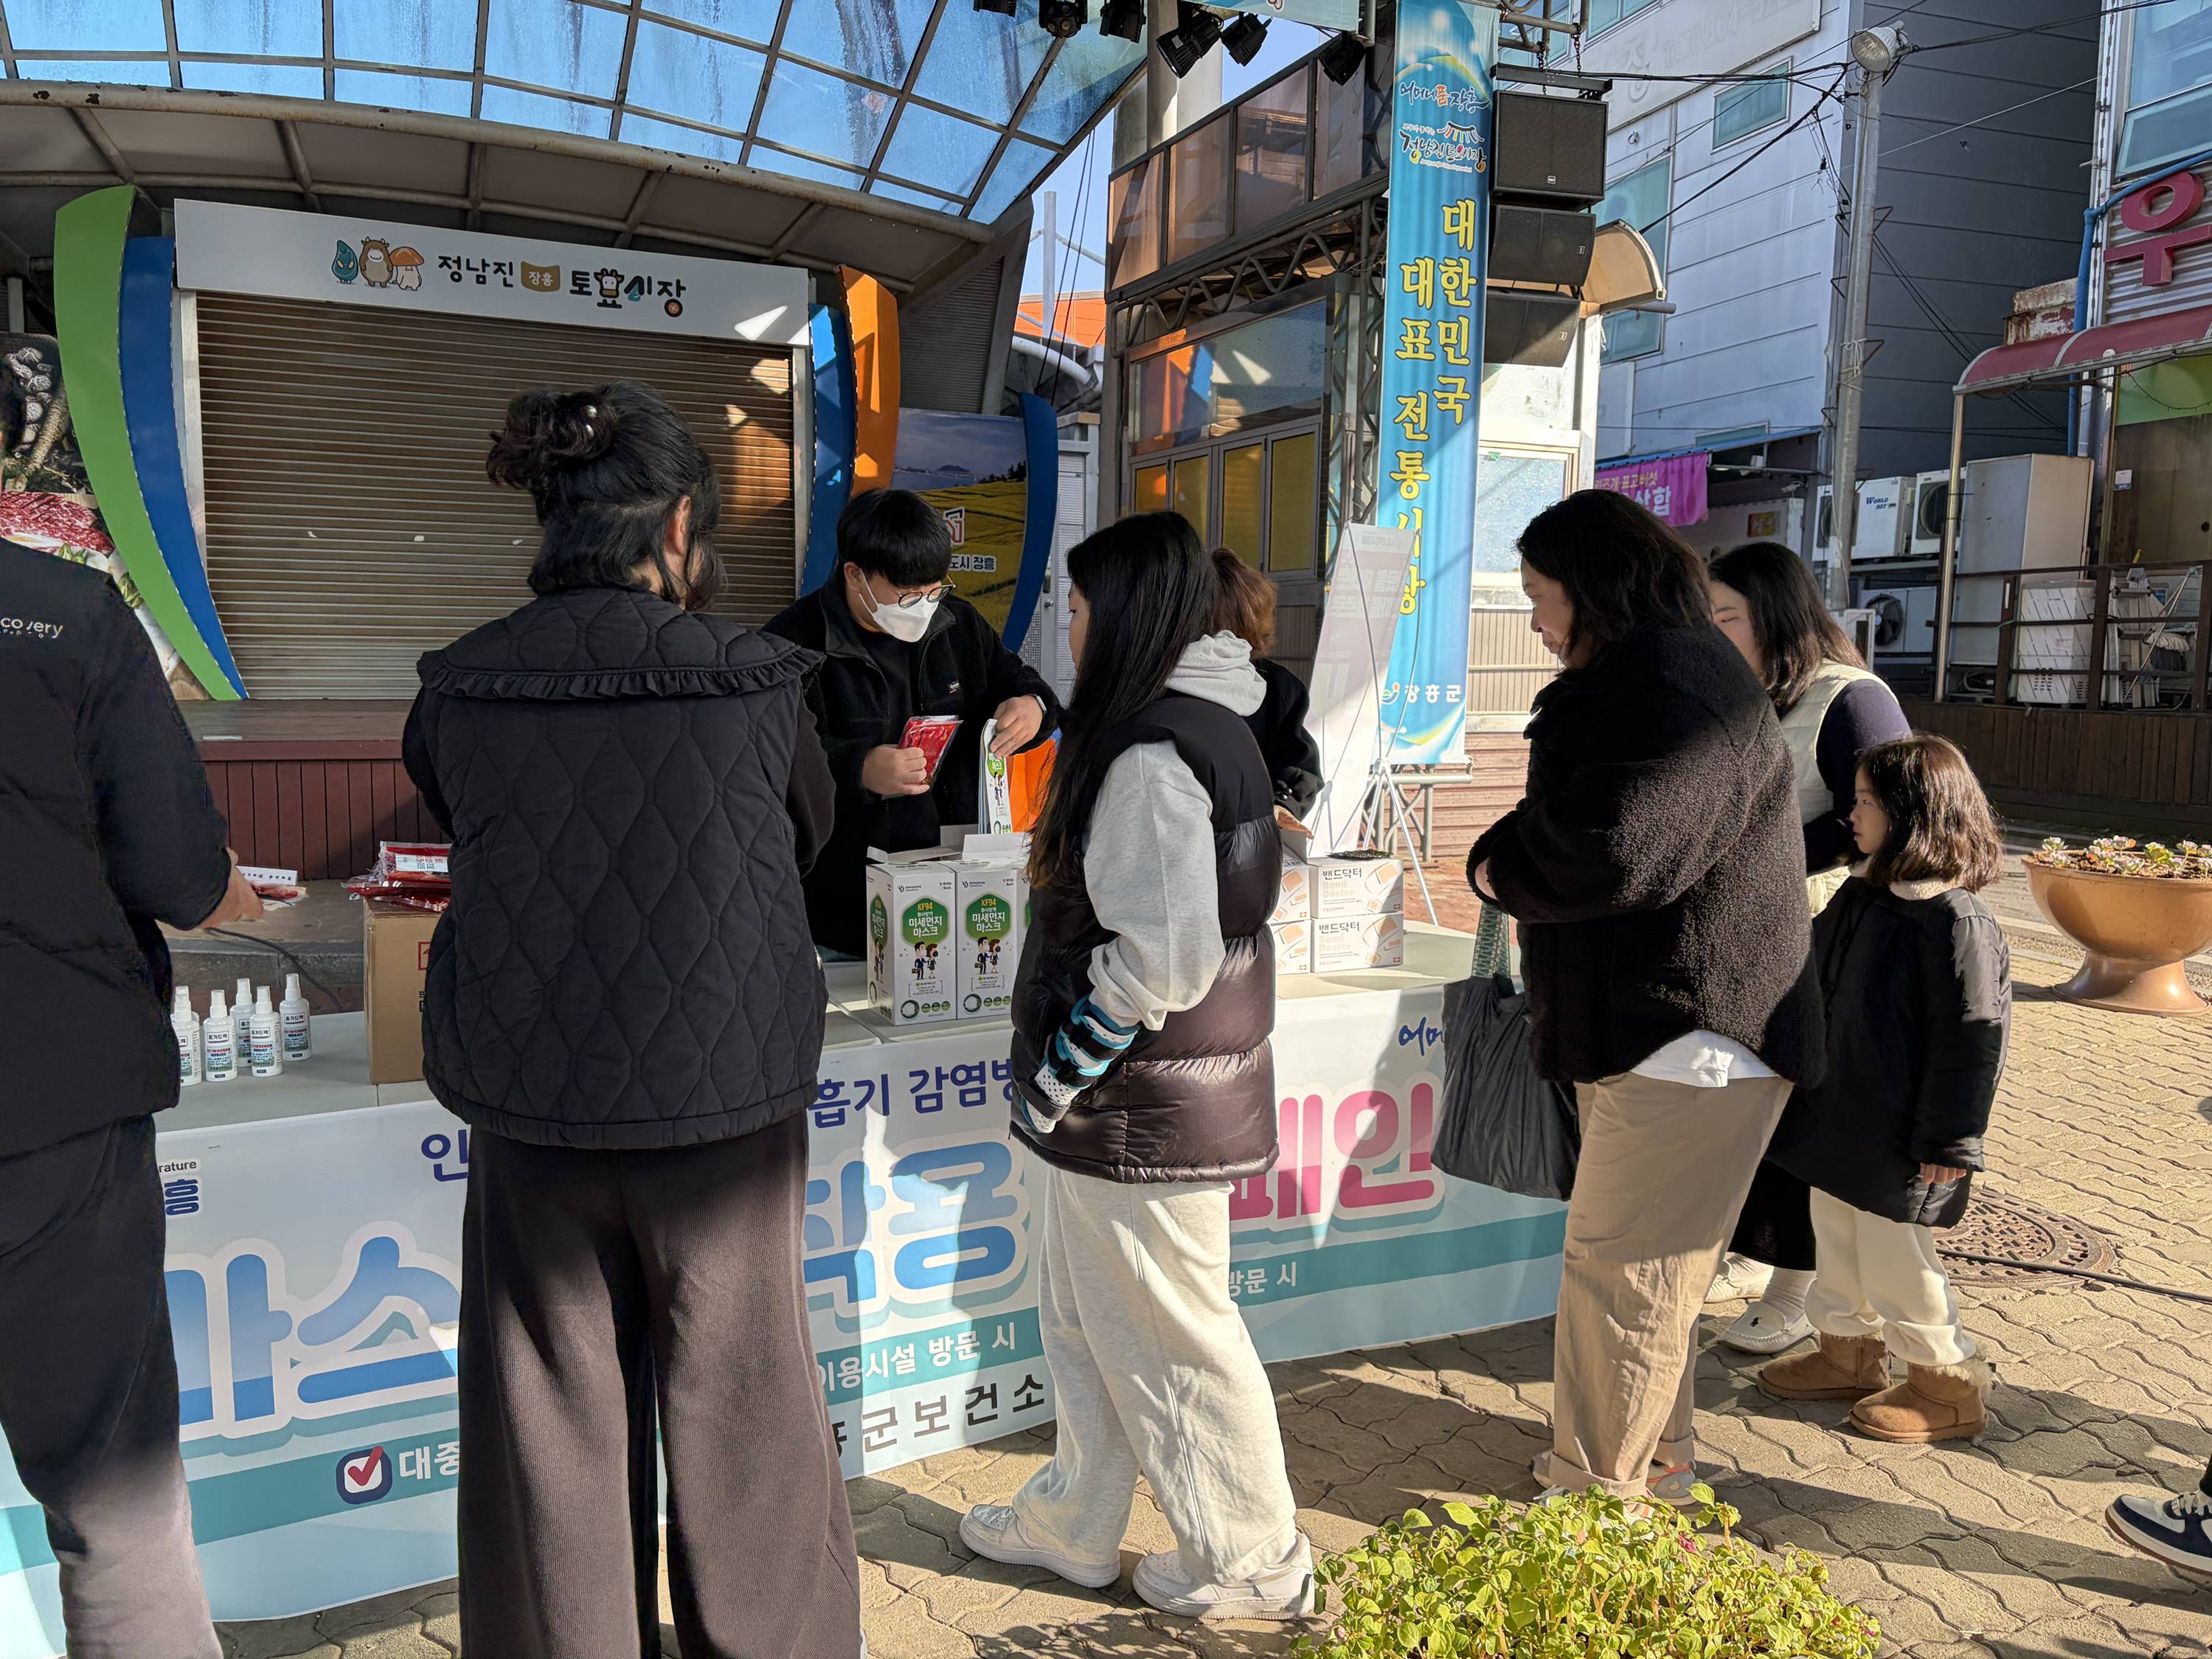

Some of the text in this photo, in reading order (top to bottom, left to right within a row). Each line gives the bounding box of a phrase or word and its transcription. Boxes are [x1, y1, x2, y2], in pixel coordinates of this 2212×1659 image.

[2103, 170, 2212, 286] 우
[437, 254, 687, 318] 정남진 장흥 토요시장
[1432, 198, 1477, 426] 대한민국
[1866, 496, 1889, 505] WORLD
[1322, 867, 1362, 880] 밴드닥터
[918, 902, 933, 911] KF94
[981, 898, 996, 907] KF94
[909, 915, 943, 927] 미세먼지
[972, 911, 1005, 923] 미세먼지
[913, 926, 939, 938] 마스크
[976, 922, 1002, 933] 마스크
[1319, 921, 1360, 934] 밴드닥터
[421, 1129, 469, 1182] 인
[808, 1073, 890, 1129] 흡기
[158, 1160, 198, 1174] rature
[1277, 1262, 1297, 1288] 시
[928, 1330, 980, 1368] 방문
[991, 1322, 1016, 1351] 시
